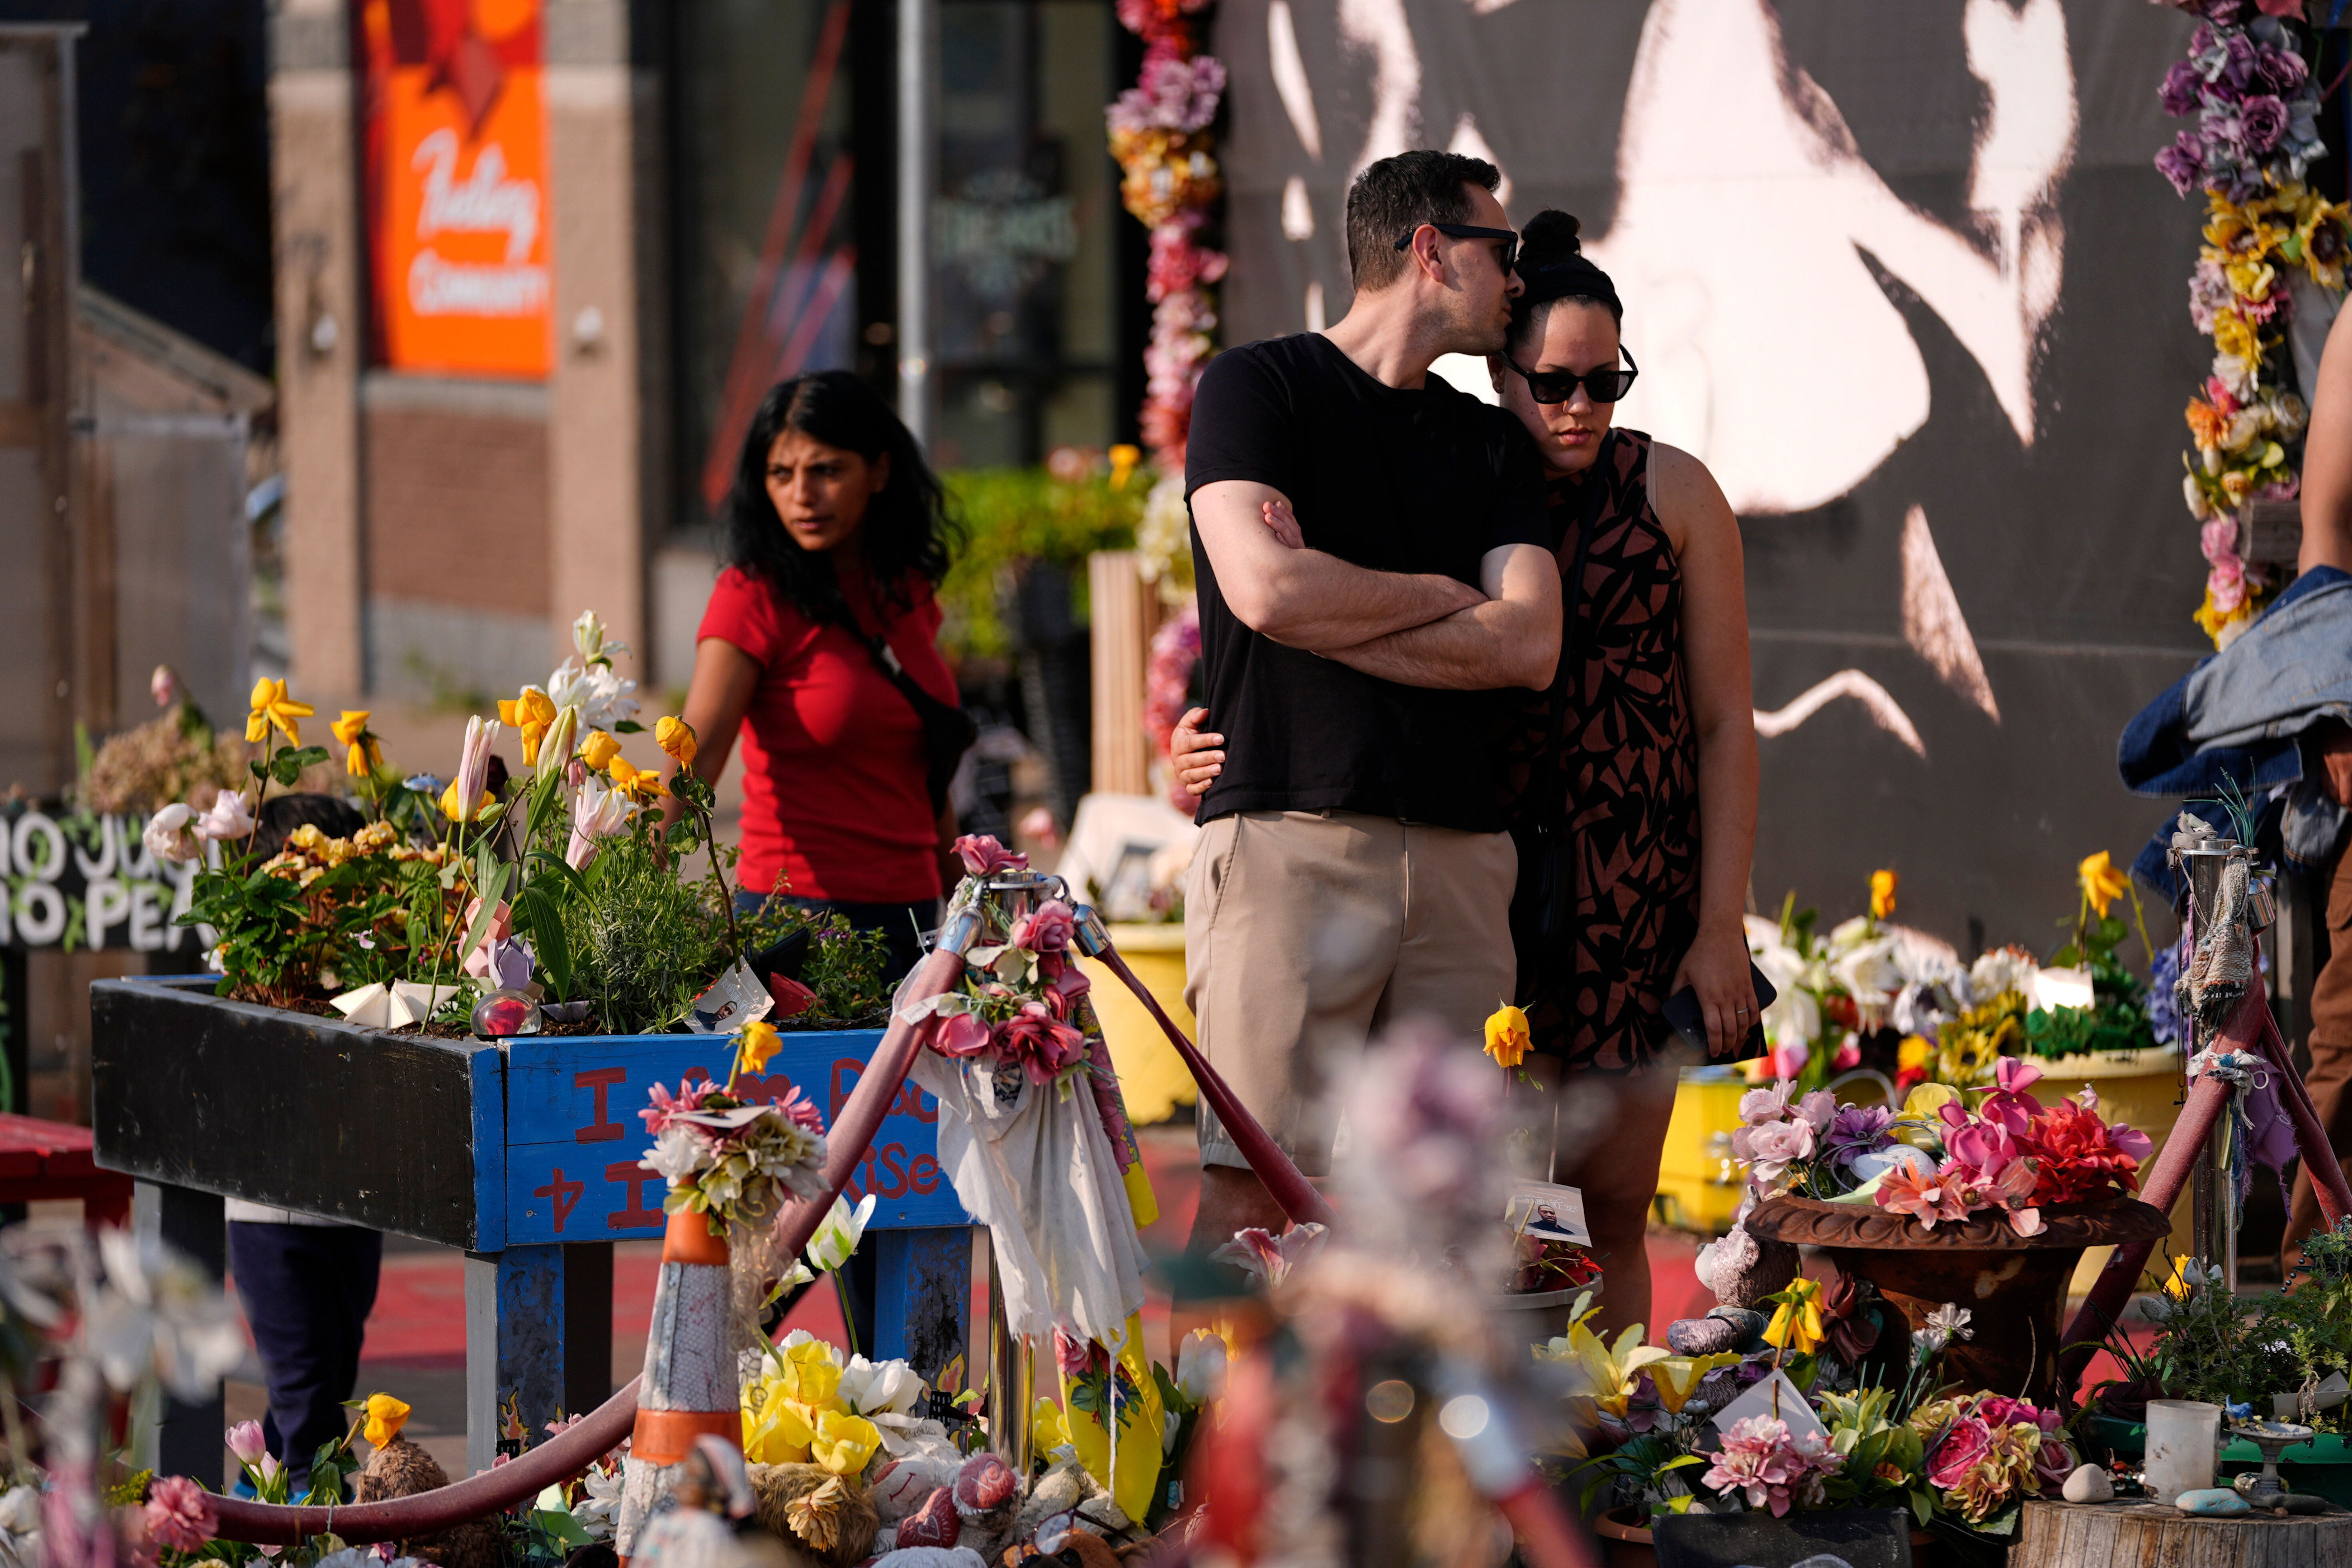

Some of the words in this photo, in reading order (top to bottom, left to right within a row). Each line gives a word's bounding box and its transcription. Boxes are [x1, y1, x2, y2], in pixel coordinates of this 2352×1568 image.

[574, 1066, 626, 1144] I
[604, 1160, 665, 1229] I
[843, 1142, 941, 1204] ise
